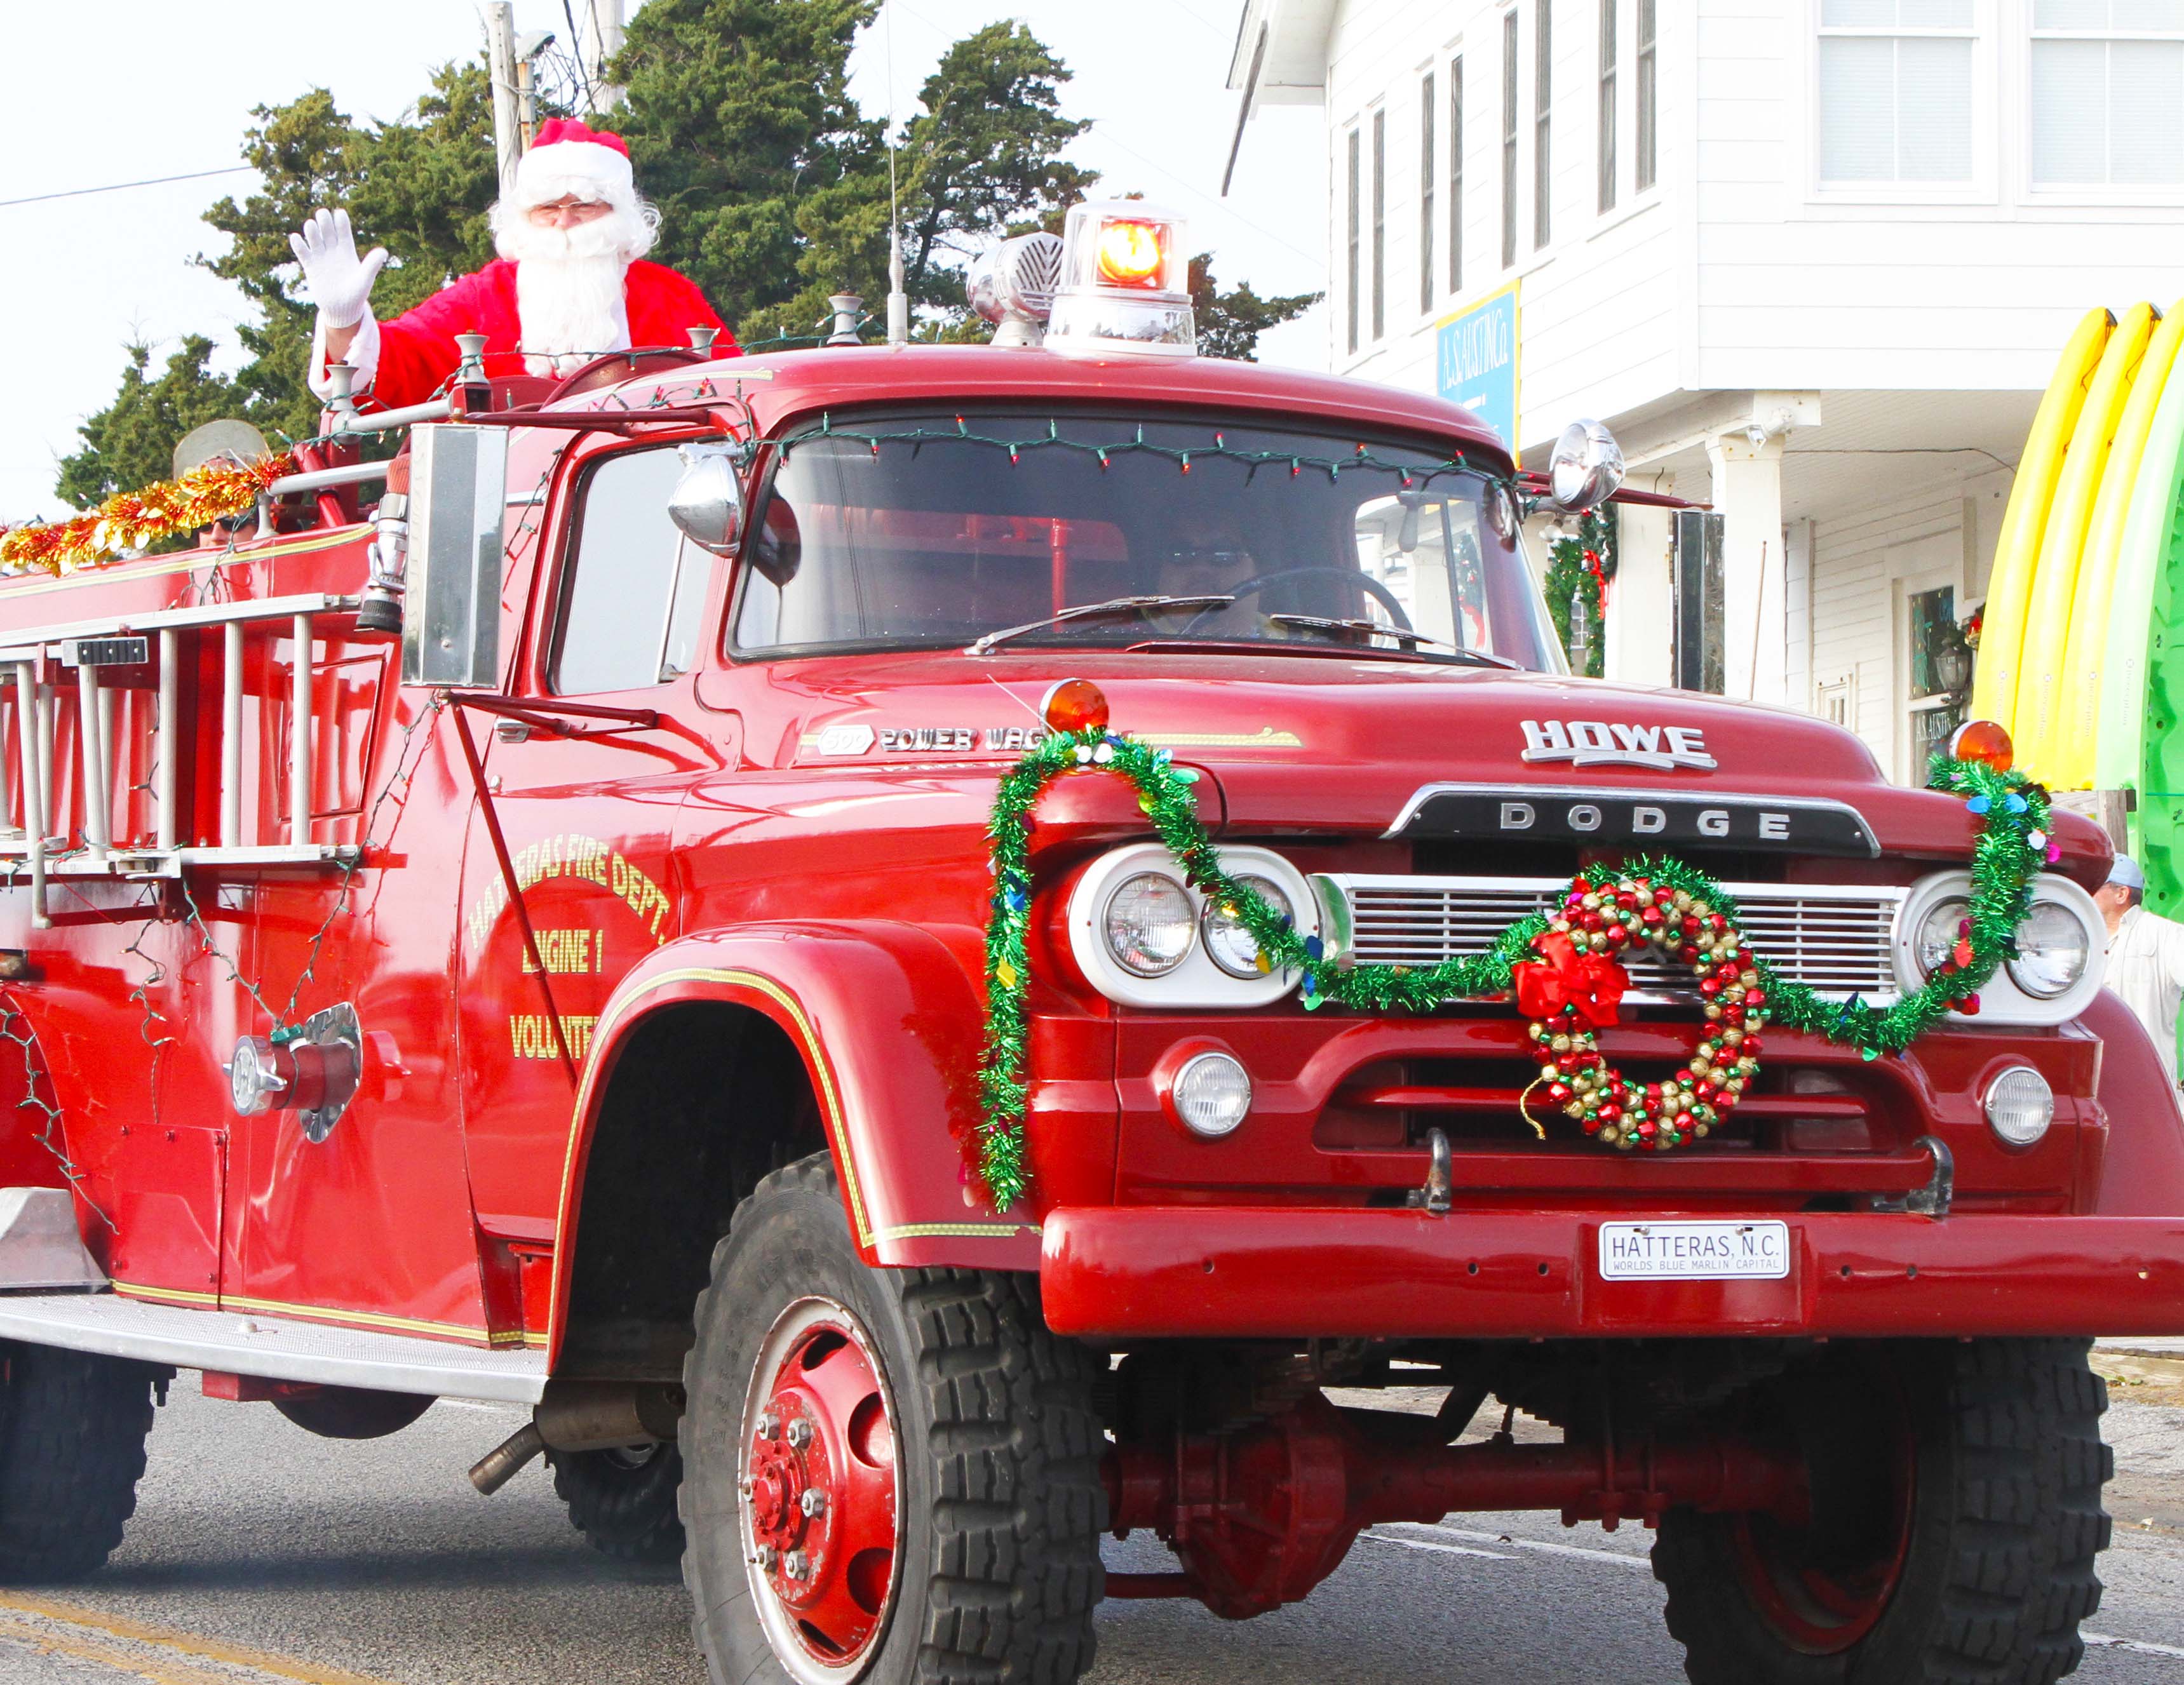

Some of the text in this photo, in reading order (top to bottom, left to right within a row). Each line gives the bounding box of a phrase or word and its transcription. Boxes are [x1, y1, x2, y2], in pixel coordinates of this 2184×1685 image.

[1462, 310, 1494, 380] AUSTIN
[880, 727, 1045, 751] POWER WAG
[1520, 720, 1713, 760] HOWE
[1500, 803, 1790, 840] DODGE
[565, 834, 610, 888] FIRE
[612, 851, 671, 946] DEPT.
[595, 929, 604, 974] 1
[1613, 1235, 1779, 1259] HATTERAS, N.C.
[1614, 1259, 1779, 1271] WORLDS BLUE MARLIN CAPITAL
